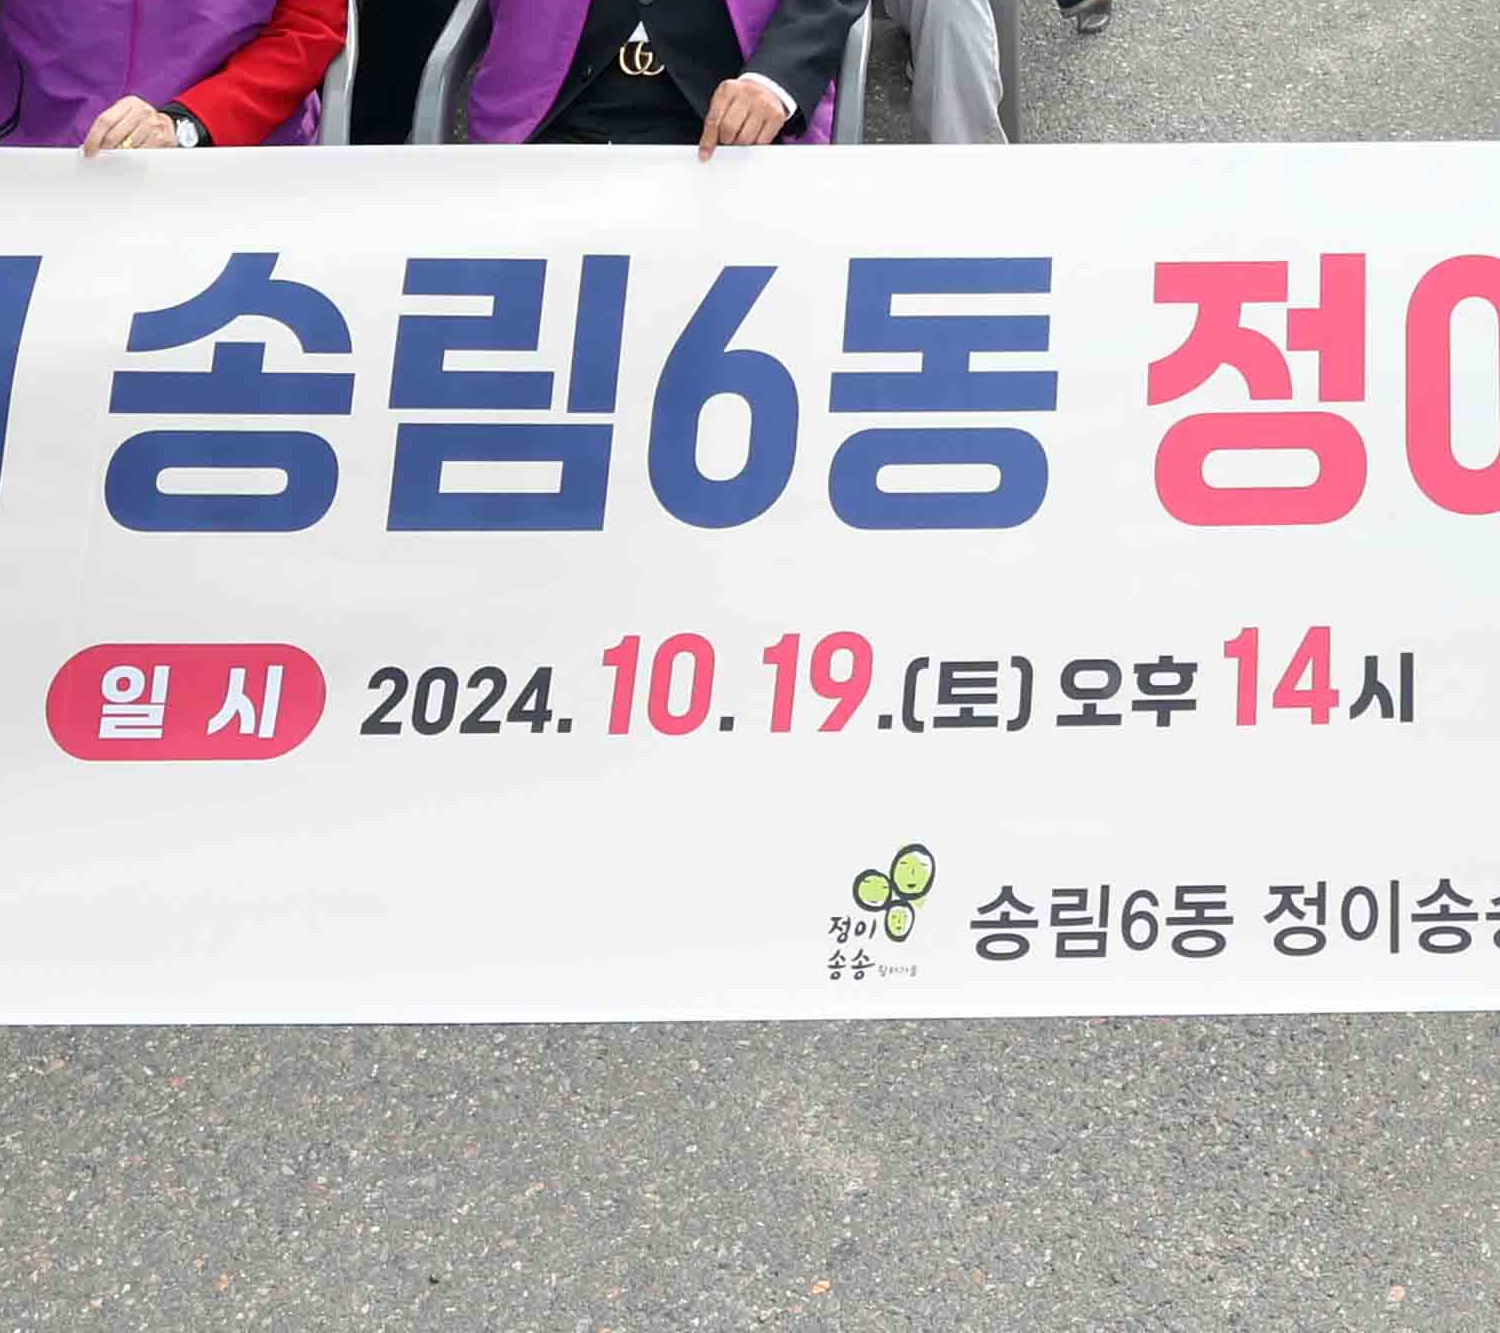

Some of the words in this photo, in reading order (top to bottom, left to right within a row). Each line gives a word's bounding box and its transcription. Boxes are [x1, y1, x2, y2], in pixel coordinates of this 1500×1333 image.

[108, 255, 1053, 528] 송림6동
[361, 667, 572, 734] 2024.
[1057, 656, 1197, 726] 오후
[1226, 628, 1412, 725] 14시
[828, 916, 877, 944] 정이
[972, 885, 1233, 960] 송림6동
[828, 948, 876, 981] 송송
